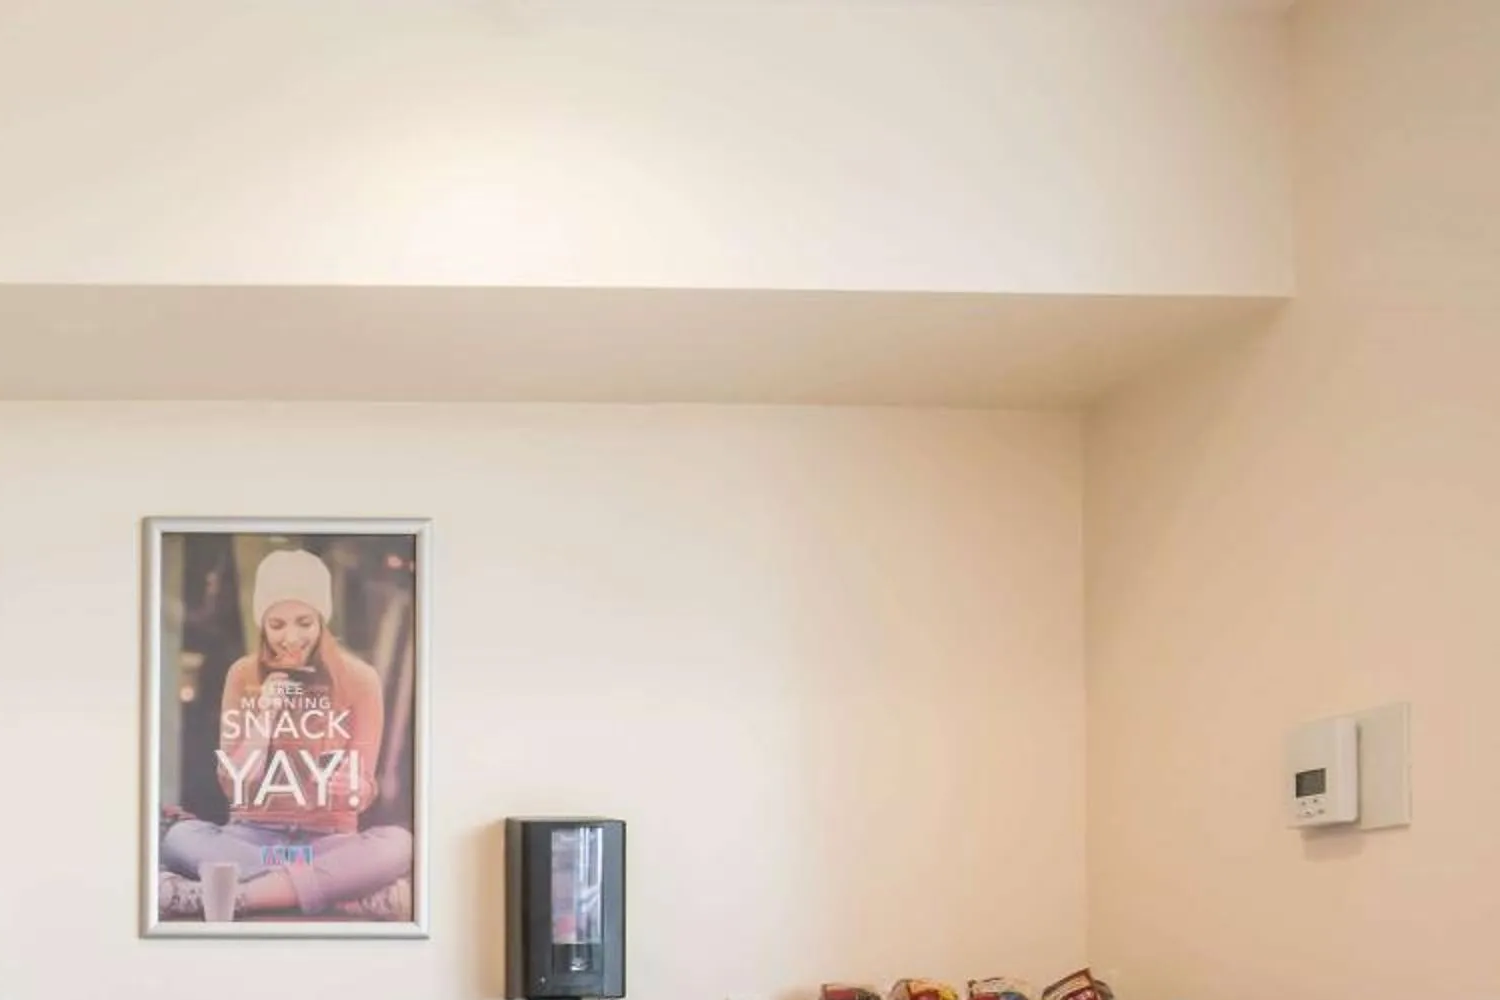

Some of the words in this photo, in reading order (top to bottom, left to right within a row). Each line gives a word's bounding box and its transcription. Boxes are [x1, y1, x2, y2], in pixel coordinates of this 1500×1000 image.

[241, 697, 332, 709] MORNING
[221, 709, 352, 740] SNACK
[214, 749, 361, 807] YAY!
